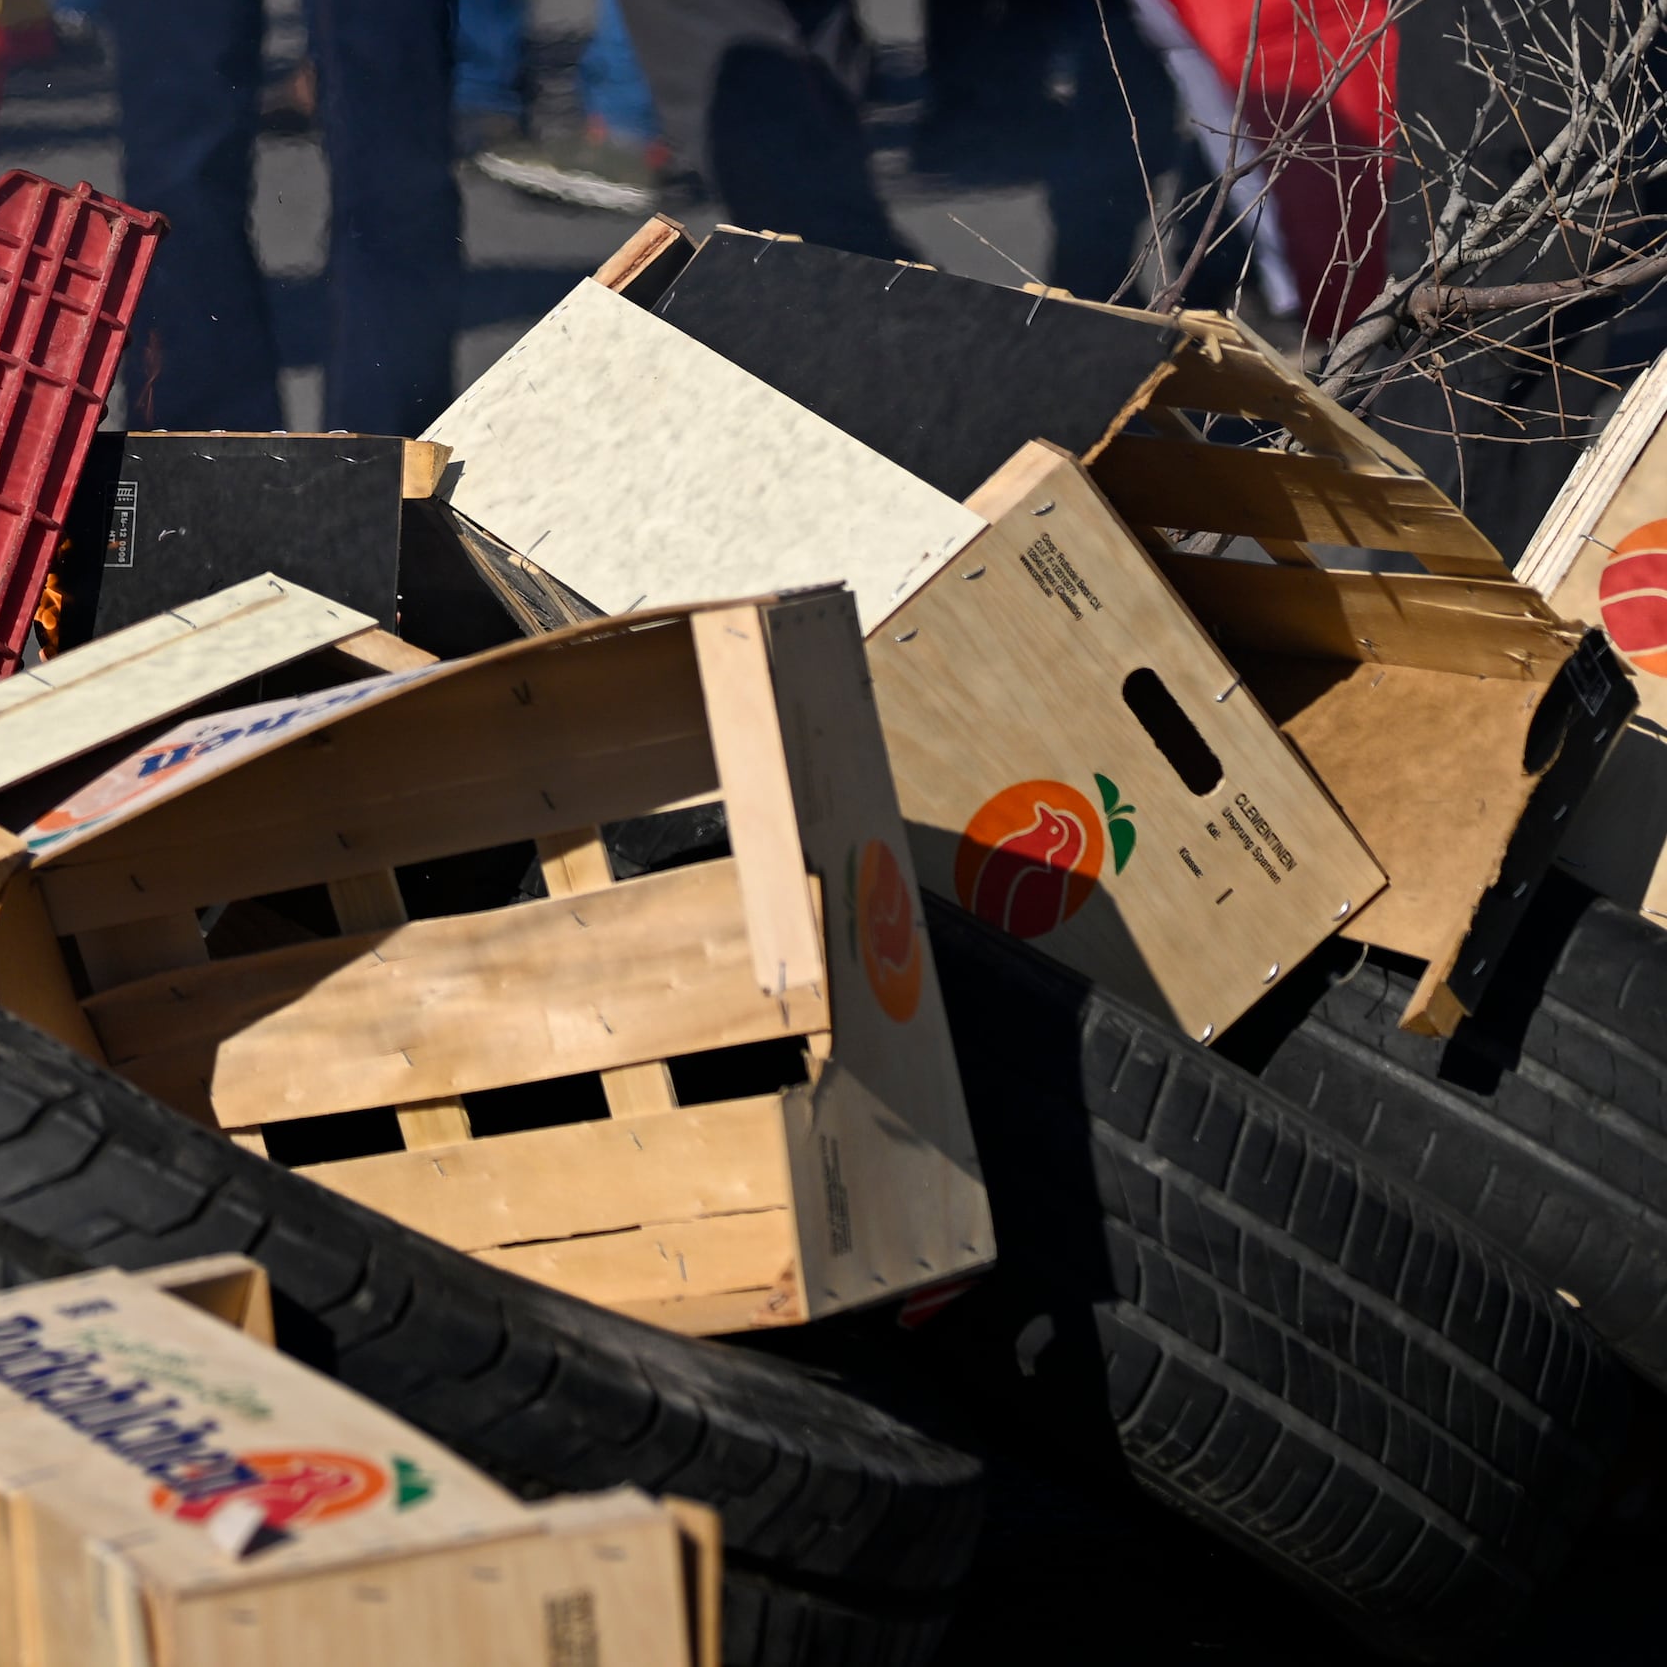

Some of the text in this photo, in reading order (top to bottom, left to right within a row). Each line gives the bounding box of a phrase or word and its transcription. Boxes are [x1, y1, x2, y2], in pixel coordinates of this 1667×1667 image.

[1222, 806, 1282, 885] Ursprung Spanien
[1235, 792, 1298, 873] CLEMENTINEN
